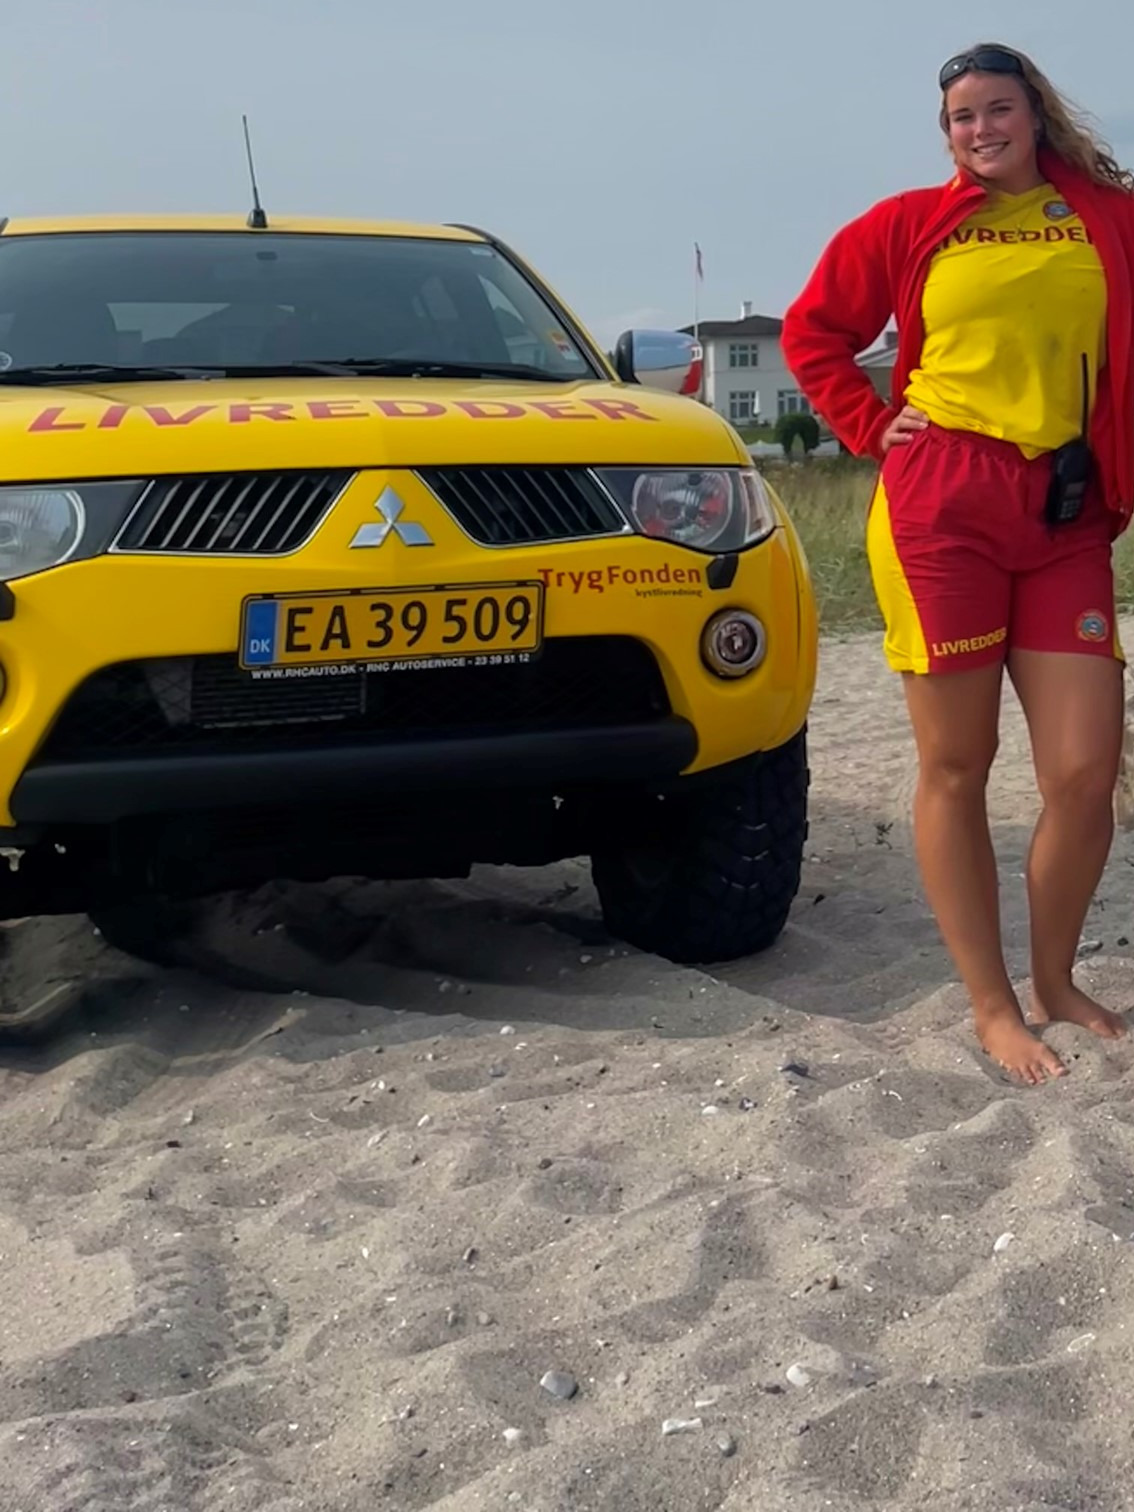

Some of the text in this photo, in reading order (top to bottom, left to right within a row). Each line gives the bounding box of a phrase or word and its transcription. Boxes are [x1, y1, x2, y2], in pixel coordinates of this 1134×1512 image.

[934, 226, 1094, 252] IVREDDE
[27, 398, 662, 433] LIVREDDER
[538, 563, 701, 594] TrygFonden
[285, 595, 531, 653] EA 39 509
[250, 639, 270, 653] DK
[392, 657, 466, 671] AUTOSERVICE
